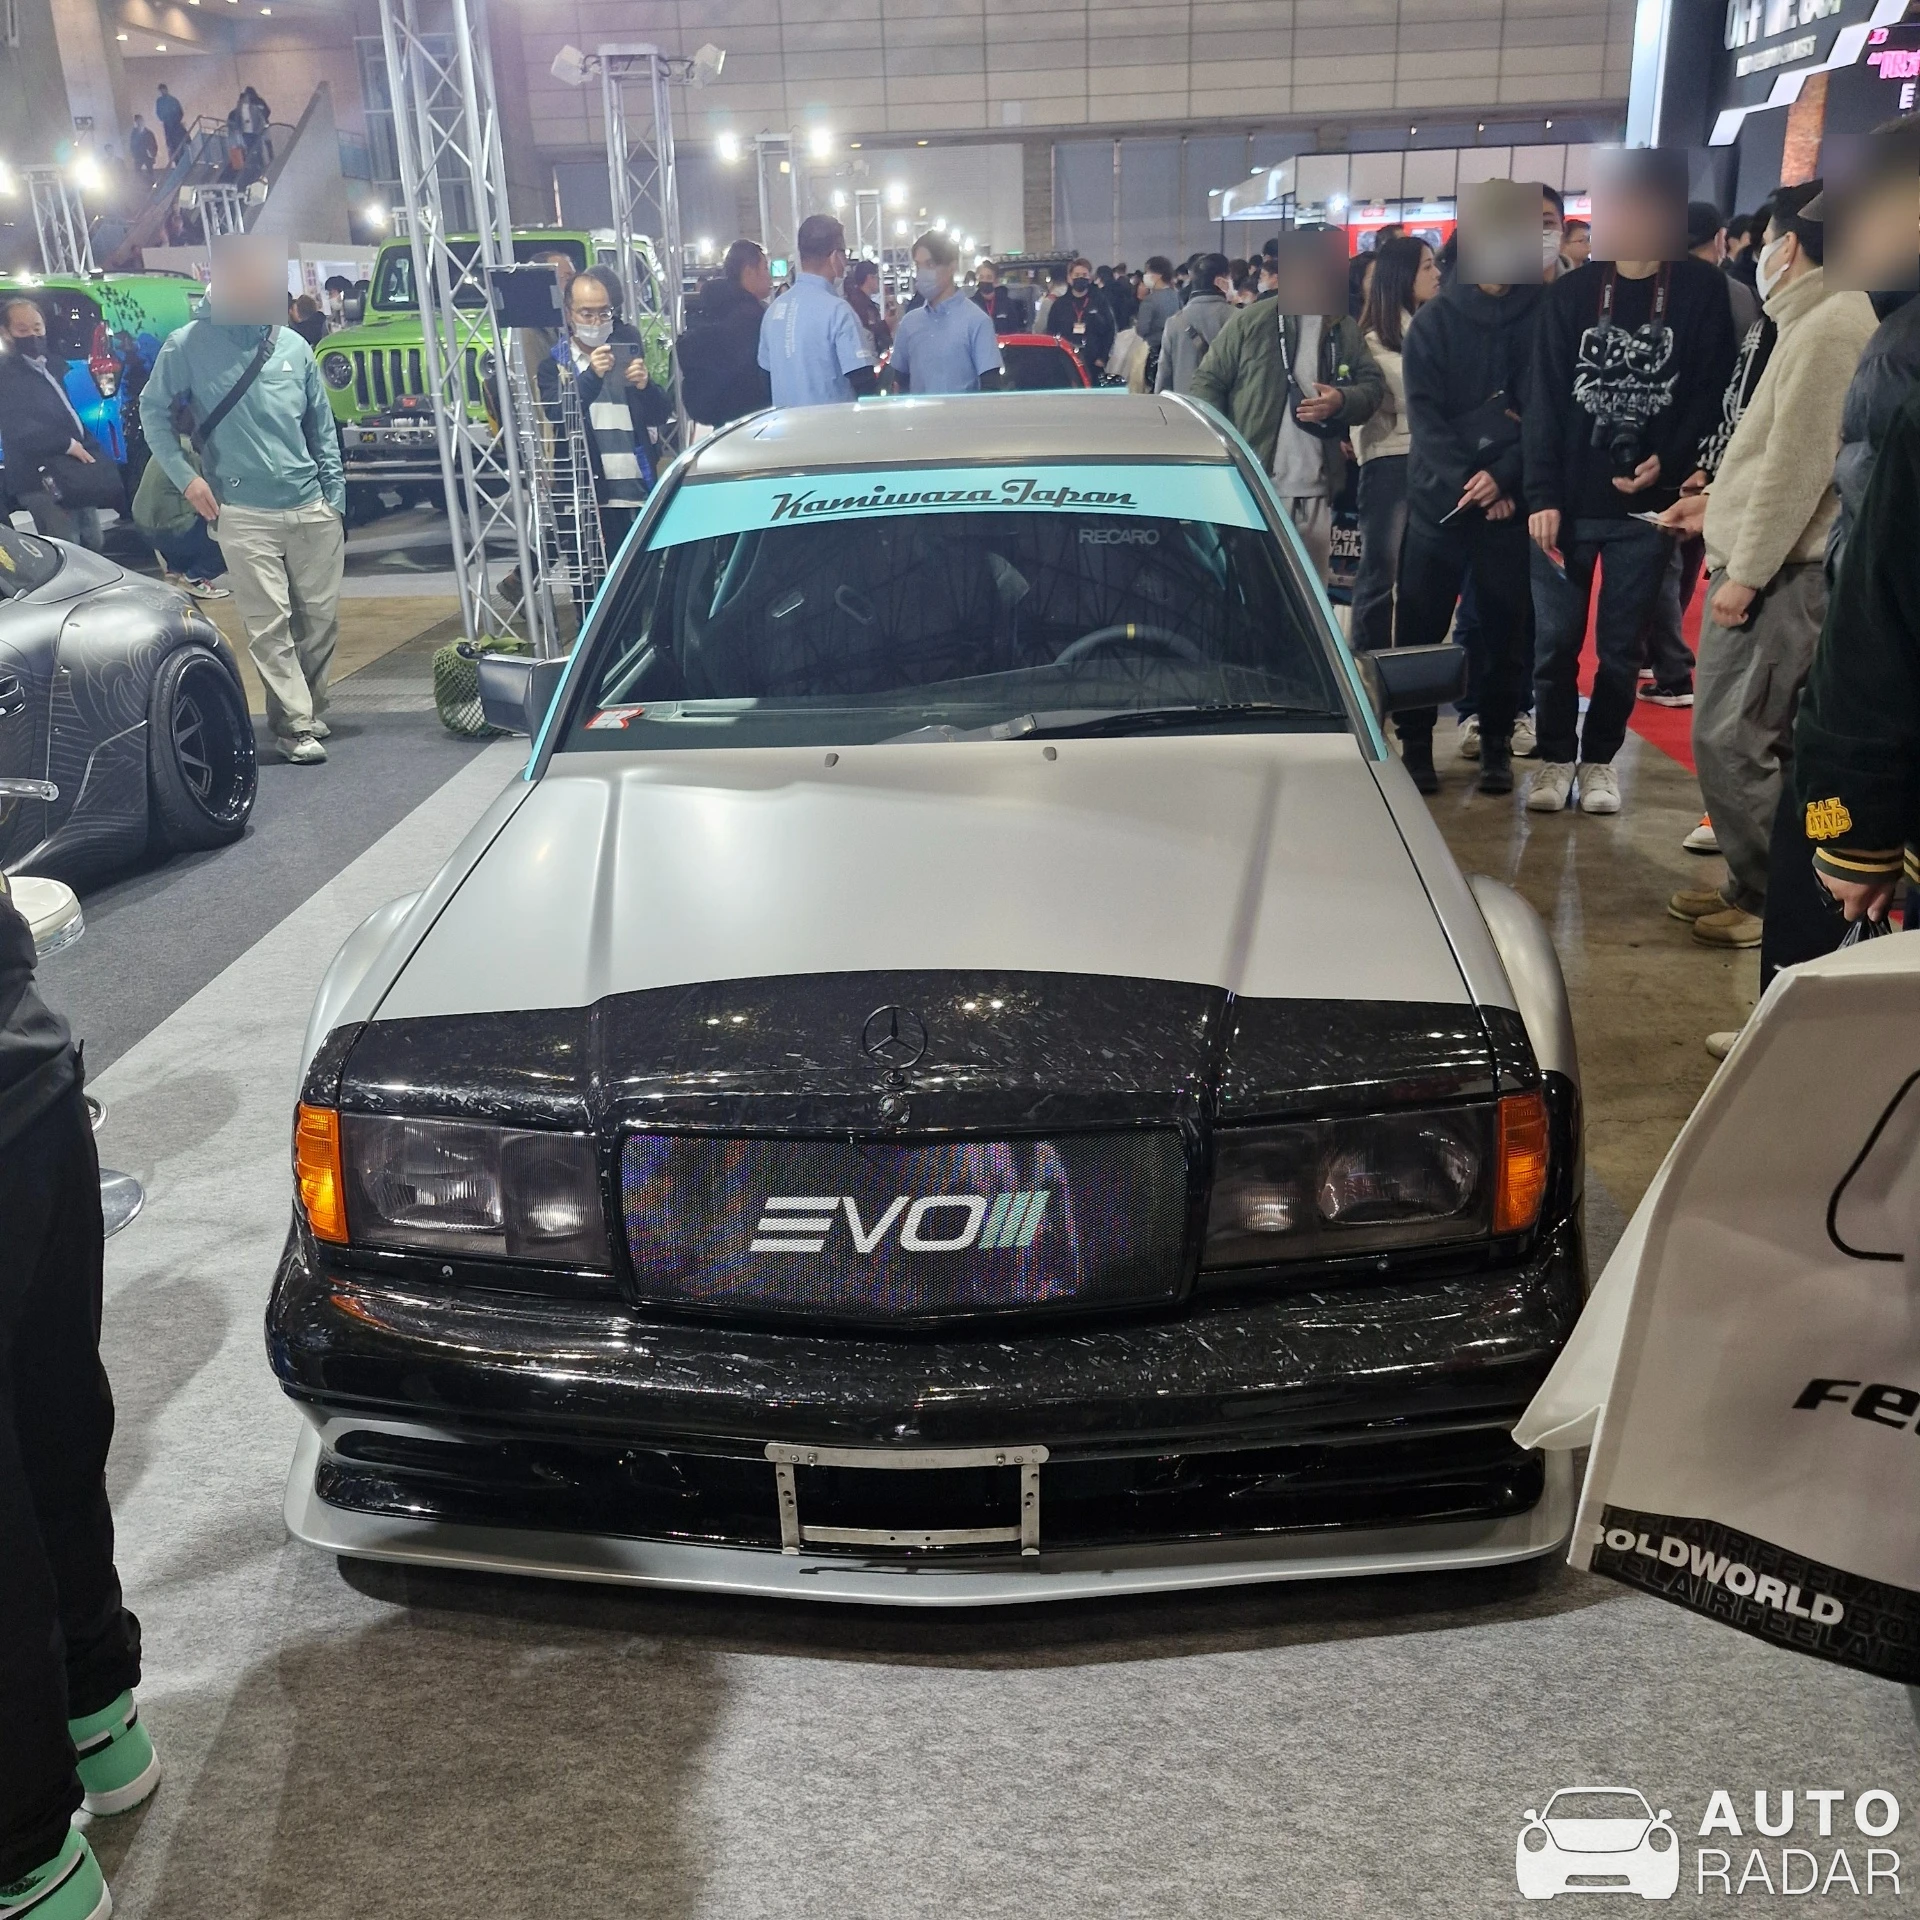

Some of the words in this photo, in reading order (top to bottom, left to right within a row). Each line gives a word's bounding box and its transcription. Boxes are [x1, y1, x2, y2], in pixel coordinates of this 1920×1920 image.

[769, 485, 997, 521] Kamiwaza
[1001, 479, 1137, 508] Japan
[1079, 529, 1160, 546] RECARO
[1791, 1378, 1920, 1437] Fe
